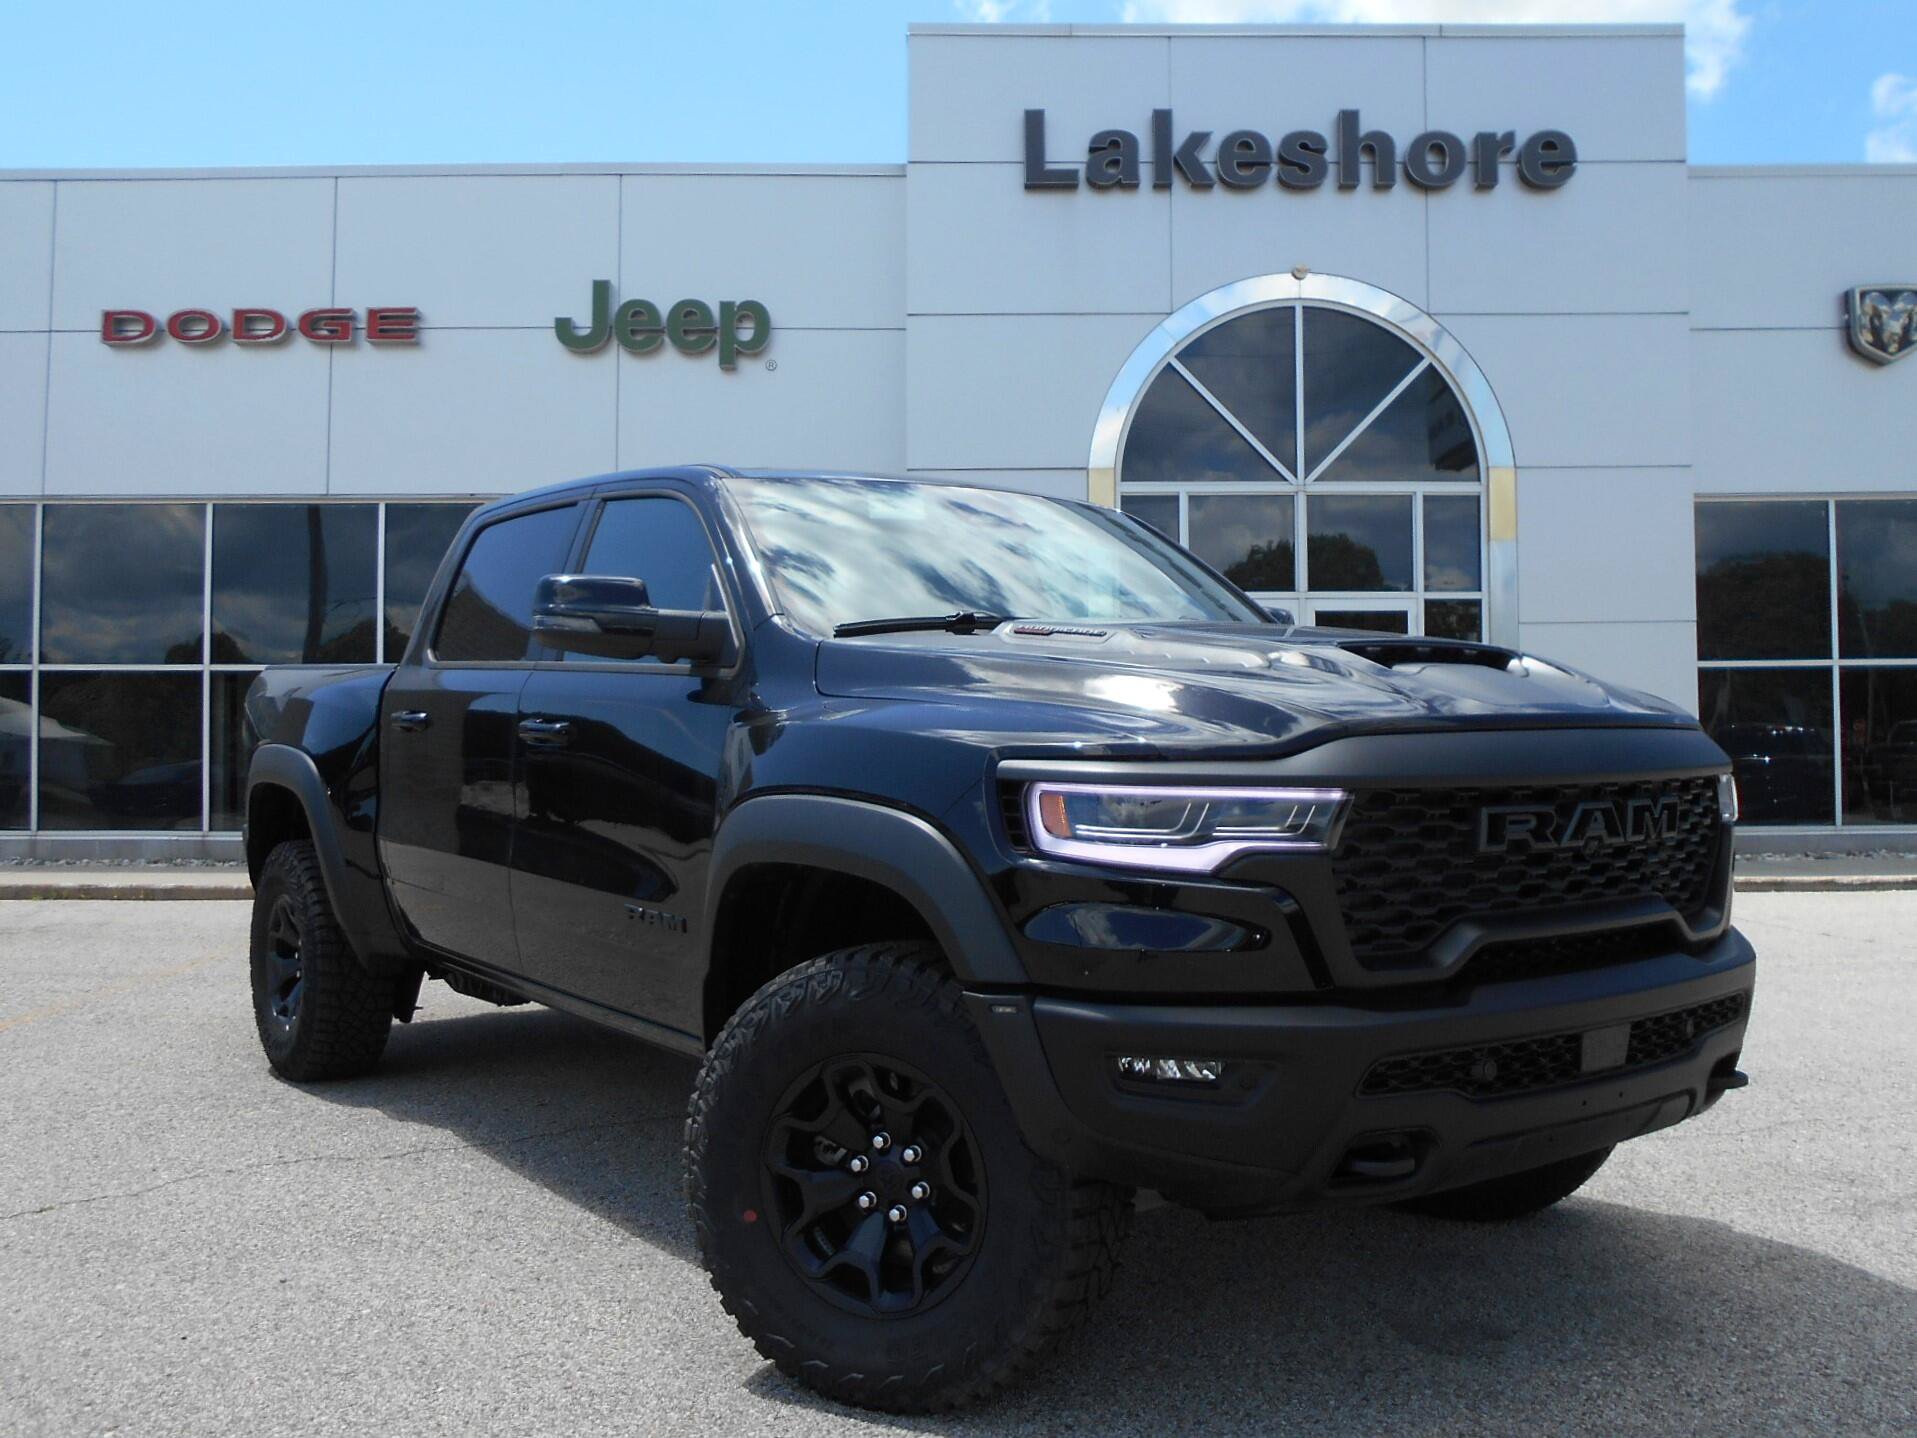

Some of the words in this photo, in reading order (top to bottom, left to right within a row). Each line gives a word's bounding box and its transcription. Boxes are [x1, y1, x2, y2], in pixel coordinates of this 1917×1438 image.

[1023, 109, 1577, 190] Lakeshore
[102, 306, 420, 346] DODGE
[555, 279, 770, 370] Jeep
[1480, 796, 1681, 852] RAM
[624, 903, 688, 934] RAM
